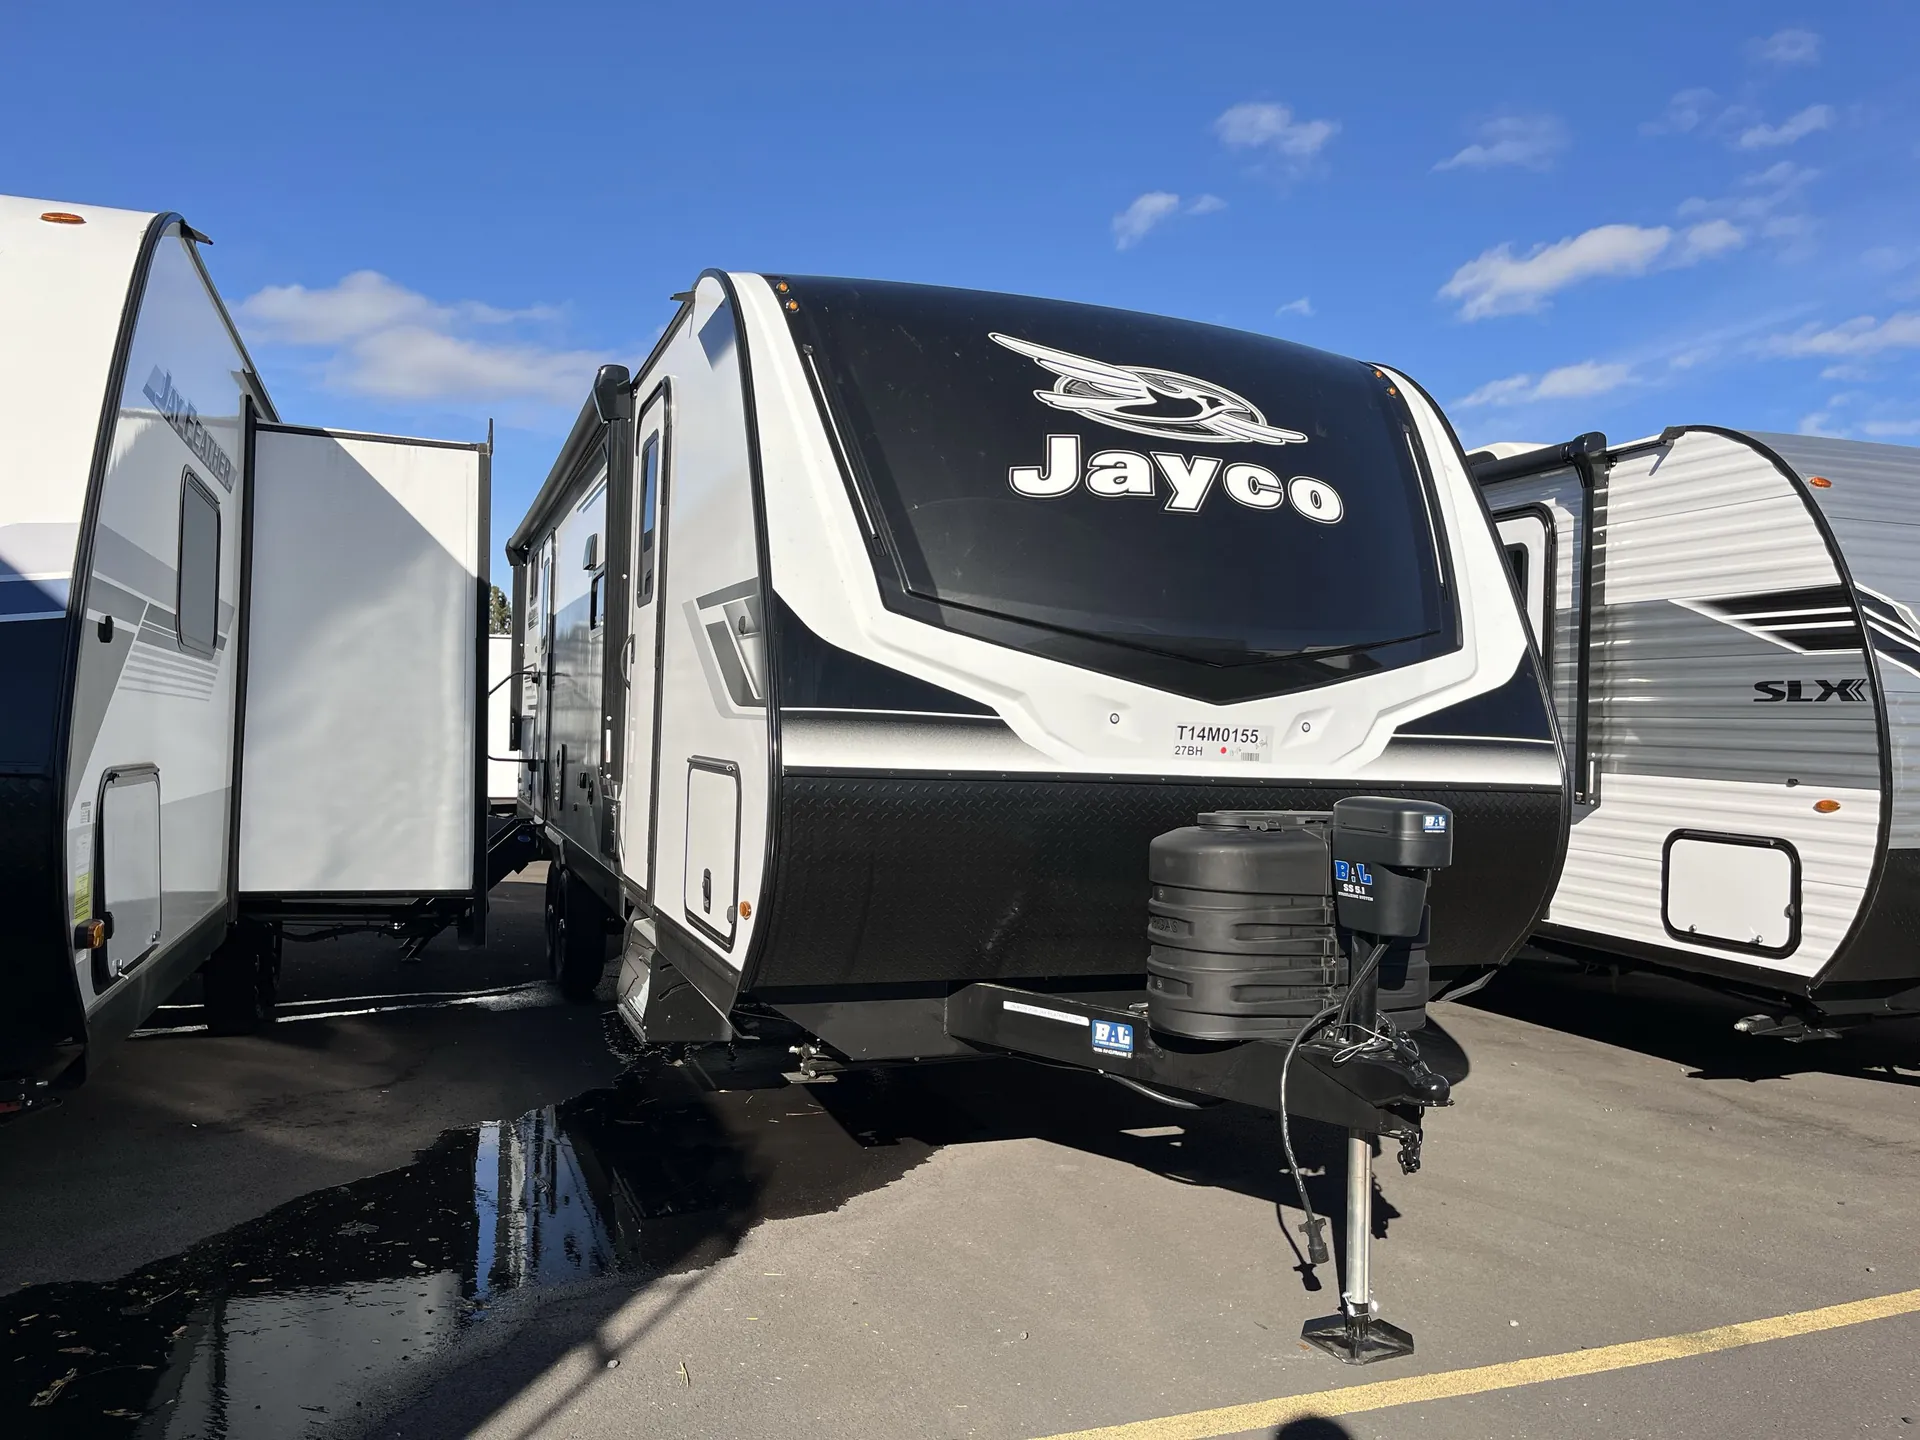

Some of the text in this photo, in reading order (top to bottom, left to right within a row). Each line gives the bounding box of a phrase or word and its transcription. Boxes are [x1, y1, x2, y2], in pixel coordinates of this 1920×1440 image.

[184, 400, 232, 490] FEATHER
[1009, 434, 1344, 524] Jayco
[1753, 678, 1867, 702] SLX
[1177, 725, 1259, 743] T14M0155
[1175, 745, 1203, 756] 27BH
